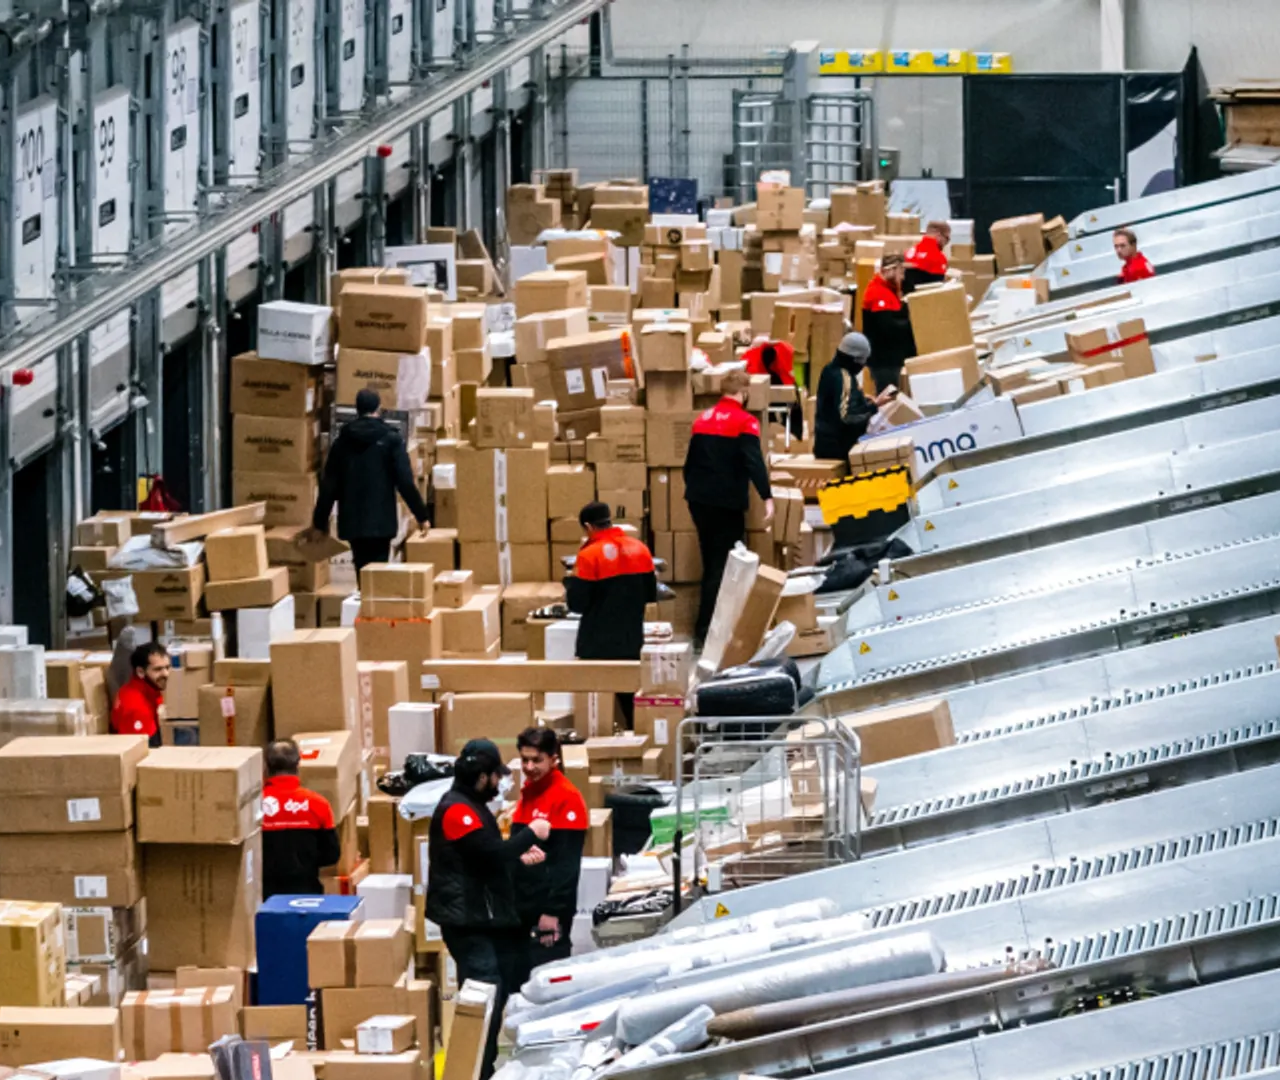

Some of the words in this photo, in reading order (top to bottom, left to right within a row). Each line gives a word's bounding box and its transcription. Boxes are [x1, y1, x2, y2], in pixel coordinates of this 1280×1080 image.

[20, 125, 45, 180] 100
[99, 115, 116, 168] 99
[284, 799, 309, 814] dpd
